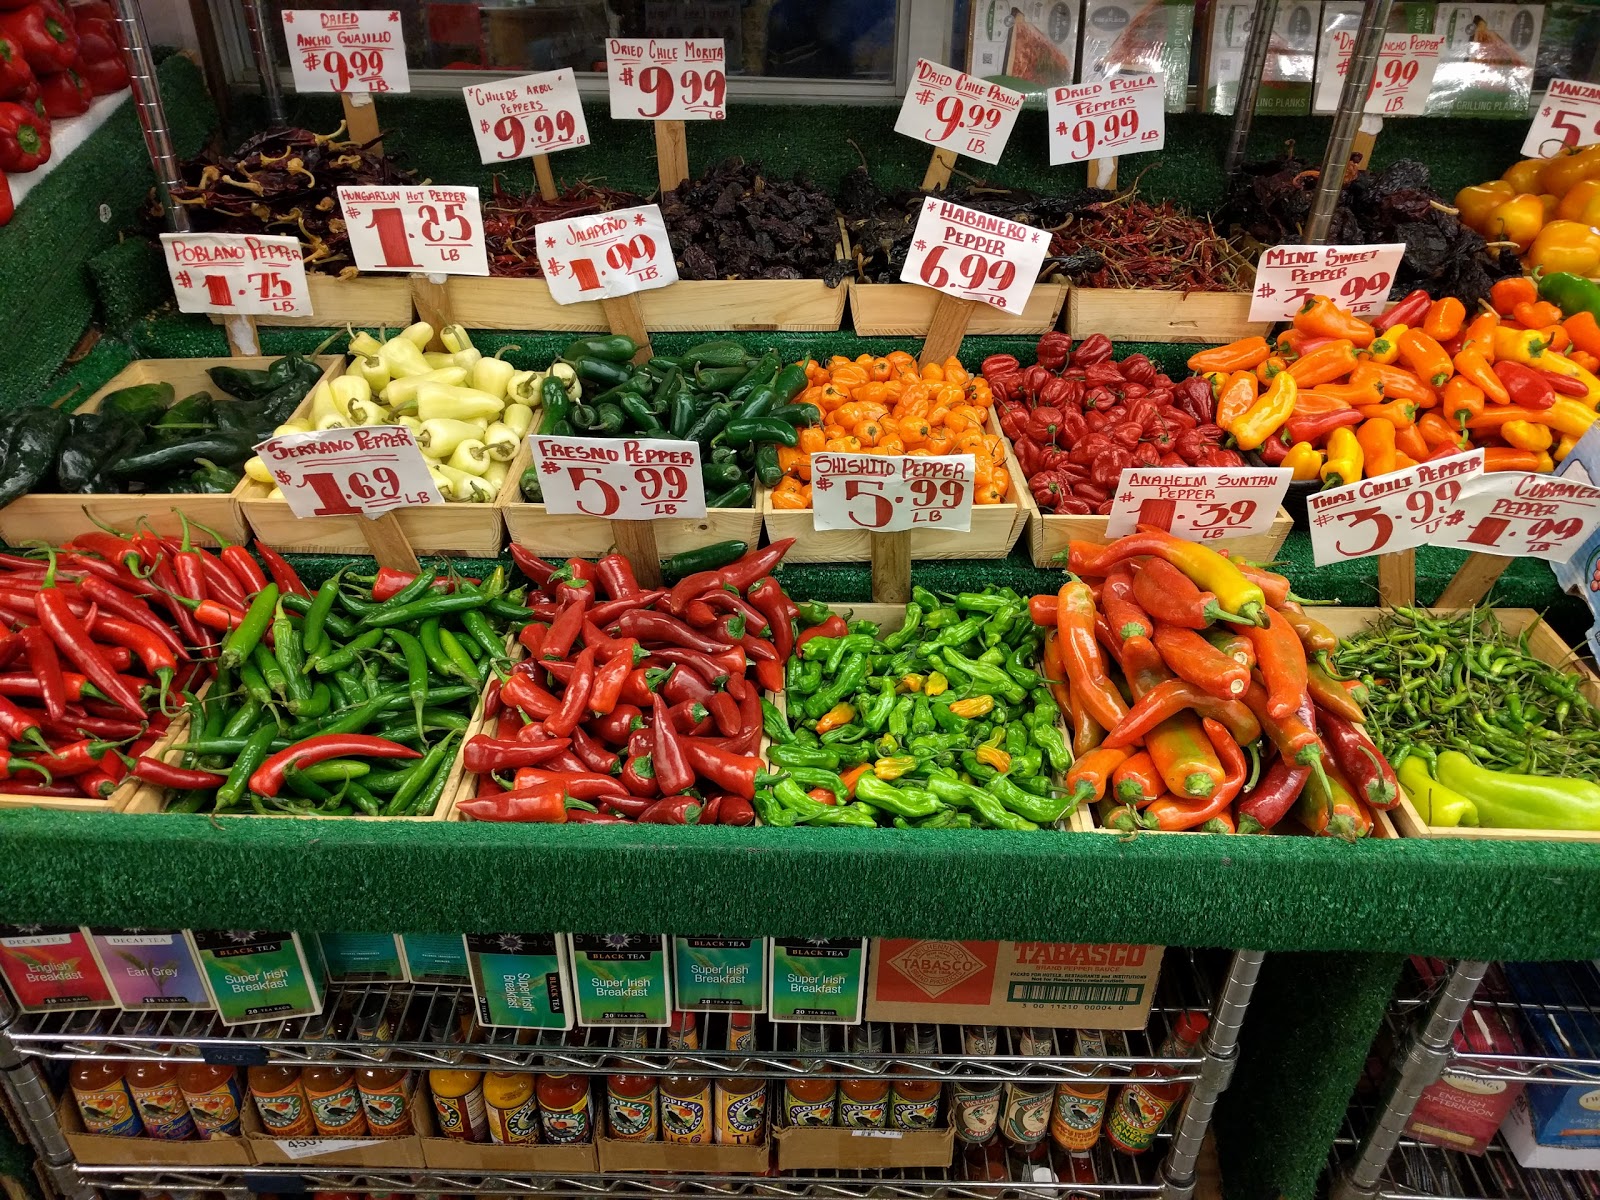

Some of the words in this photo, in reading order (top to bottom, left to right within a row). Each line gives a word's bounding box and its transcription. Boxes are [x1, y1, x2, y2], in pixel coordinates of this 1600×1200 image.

[320, 12, 359, 28] DRIED
[297, 33, 331, 47] ANCHO
[337, 31, 391, 44] GUAJILLO
[1381, 40, 1406, 51] NCHO
[1410, 34, 1439, 50] PEPPER
[610, 40, 643, 58] DRIED
[649, 40, 678, 59] CHILE
[685, 41, 723, 59] MORITA
[303, 51, 384, 92] $9.99
[919, 63, 953, 86] DRIED
[955, 73, 986, 96] CHILE
[987, 84, 1020, 107] PASILLA
[1054, 84, 1102, 103] DRIED
[1109, 75, 1156, 91] PULLA
[1336, 58, 1419, 103] $.99
[526, 84, 554, 95] ARBOL
[500, 101, 543, 114] PEPPERS
[1075, 96, 1136, 116] PEPPERS
[1276, 98, 1305, 107] PLANKS
[1457, 101, 1492, 110] GRILLING
[1494, 101, 1525, 111] PLANKS
[915, 89, 1002, 141] $9.99
[480, 110, 575, 159] $9.99
[576, 135, 586, 145] LB
[1056, 109, 1139, 159] $9.99
[1141, 130, 1159, 141] LB
[406, 191, 424, 201] HOT
[429, 190, 467, 201] PEPPER
[940, 202, 1027, 239] HABANERO
[346, 204, 472, 267] $1.25
[566, 217, 627, 245] JALAPEÑO
[172, 240, 245, 262] POBLANO
[244, 236, 302, 261] PEPPER
[945, 227, 1005, 255] PEPPER
[440, 249, 460, 261] LB
[1266, 249, 1318, 265] MINI
[1325, 248, 1380, 266] SWEET
[914, 240, 1016, 291] $6.99
[1292, 267, 1348, 281] PEPPER
[175, 270, 292, 306] $1.75
[989, 297, 1007, 308] LB
[267, 440, 354, 460] SERRANO
[353, 430, 413, 451] PEPPER
[538, 440, 619, 461] FRESNO
[624, 440, 694, 464] PEPPER
[815, 456, 896, 475] SHISHITO
[902, 458, 965, 479] PEPPER
[1129, 473, 1207, 486] ANAHEIM
[1218, 474, 1277, 486] SUNTAN
[1309, 489, 1357, 510] THAI
[1359, 476, 1413, 499] CHILI
[1416, 457, 1483, 482] PEPPER
[274, 467, 400, 516] $1.69
[541, 461, 688, 516] $5.99
[1159, 486, 1215, 500] PEPPER
[405, 492, 430, 504] LB
[816, 477, 964, 528] $5.99
[655, 504, 677, 514] LB
[1119, 492, 1257, 537] $1.39
[1490, 499, 1560, 516] PEPPER
[913, 510, 942, 523] LB
[1202, 529, 1224, 538] LB
[1444, 509, 1583, 547] $1.99
[1526, 542, 1550, 553] LB
[44, 936, 65, 944] TEA
[220, 947, 254, 956] BLACK
[1013, 941, 1148, 967] TABASCO
[28, 961, 72, 974] English
[126, 967, 149, 977] Earl
[151, 967, 178, 978] Grey
[691, 964, 722, 975] Super
[726, 965, 749, 975] Irish
[25, 970, 84, 983] Breakfast
[225, 973, 260, 985] Super
[263, 969, 289, 980] Irish
[517, 973, 531, 994] Super
[591, 977, 623, 989] Super
[627, 978, 651, 987] Irish
[695, 974, 746, 984] Breakfast
[787, 973, 819, 984] Super
[823, 974, 845, 984] Irish
[232, 979, 289, 993] Breakfast
[503, 974, 519, 1009] Breakfast
[549, 976, 559, 997] BLACK
[596, 987, 648, 997] Breakfast
[790, 983, 842, 994] Breakfast
[521, 995, 536, 1012] Irish
[552, 998, 560, 1011] TEA
[1424, 1094, 1495, 1117] AFTERNOON
[1439, 1091, 1486, 1108] ENGLISH
